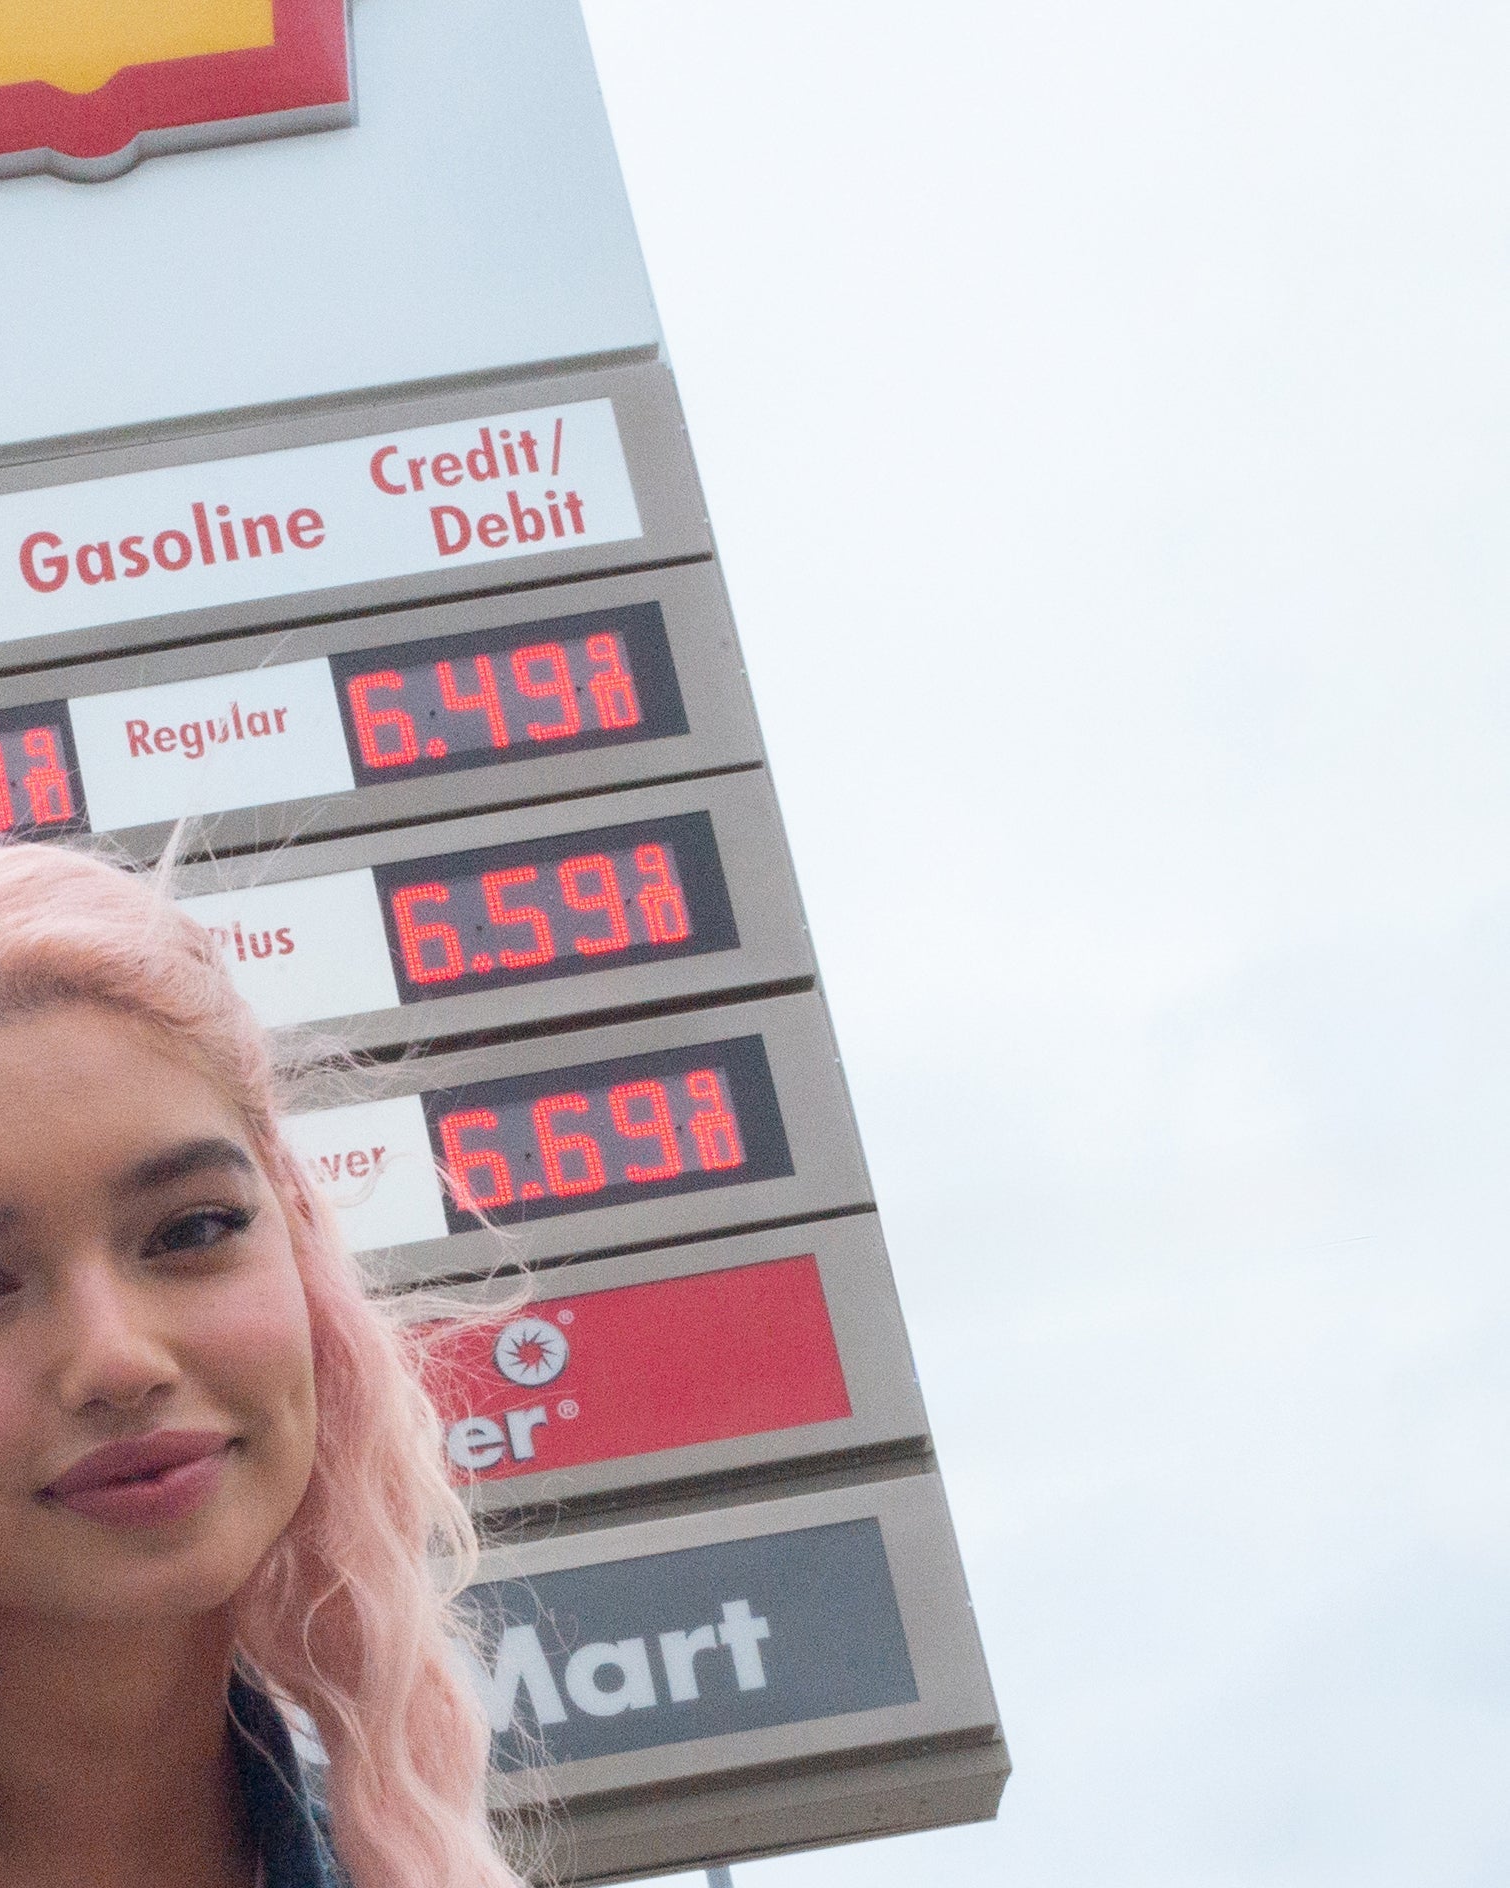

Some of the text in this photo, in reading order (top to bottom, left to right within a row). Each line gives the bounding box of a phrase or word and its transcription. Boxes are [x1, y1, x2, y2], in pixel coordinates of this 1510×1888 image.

[370, 420, 562, 495] Credit/
[19, 502, 325, 593] Gasoline
[430, 491, 585, 556] Debit
[125, 702, 288, 759] Regular
[348, 642, 581, 768] 6.49
[393, 854, 631, 985] 6.59
[307, 1146, 386, 1184] wer
[440, 1080, 683, 1210] 6.69
[452, 1598, 770, 1734] Mart
